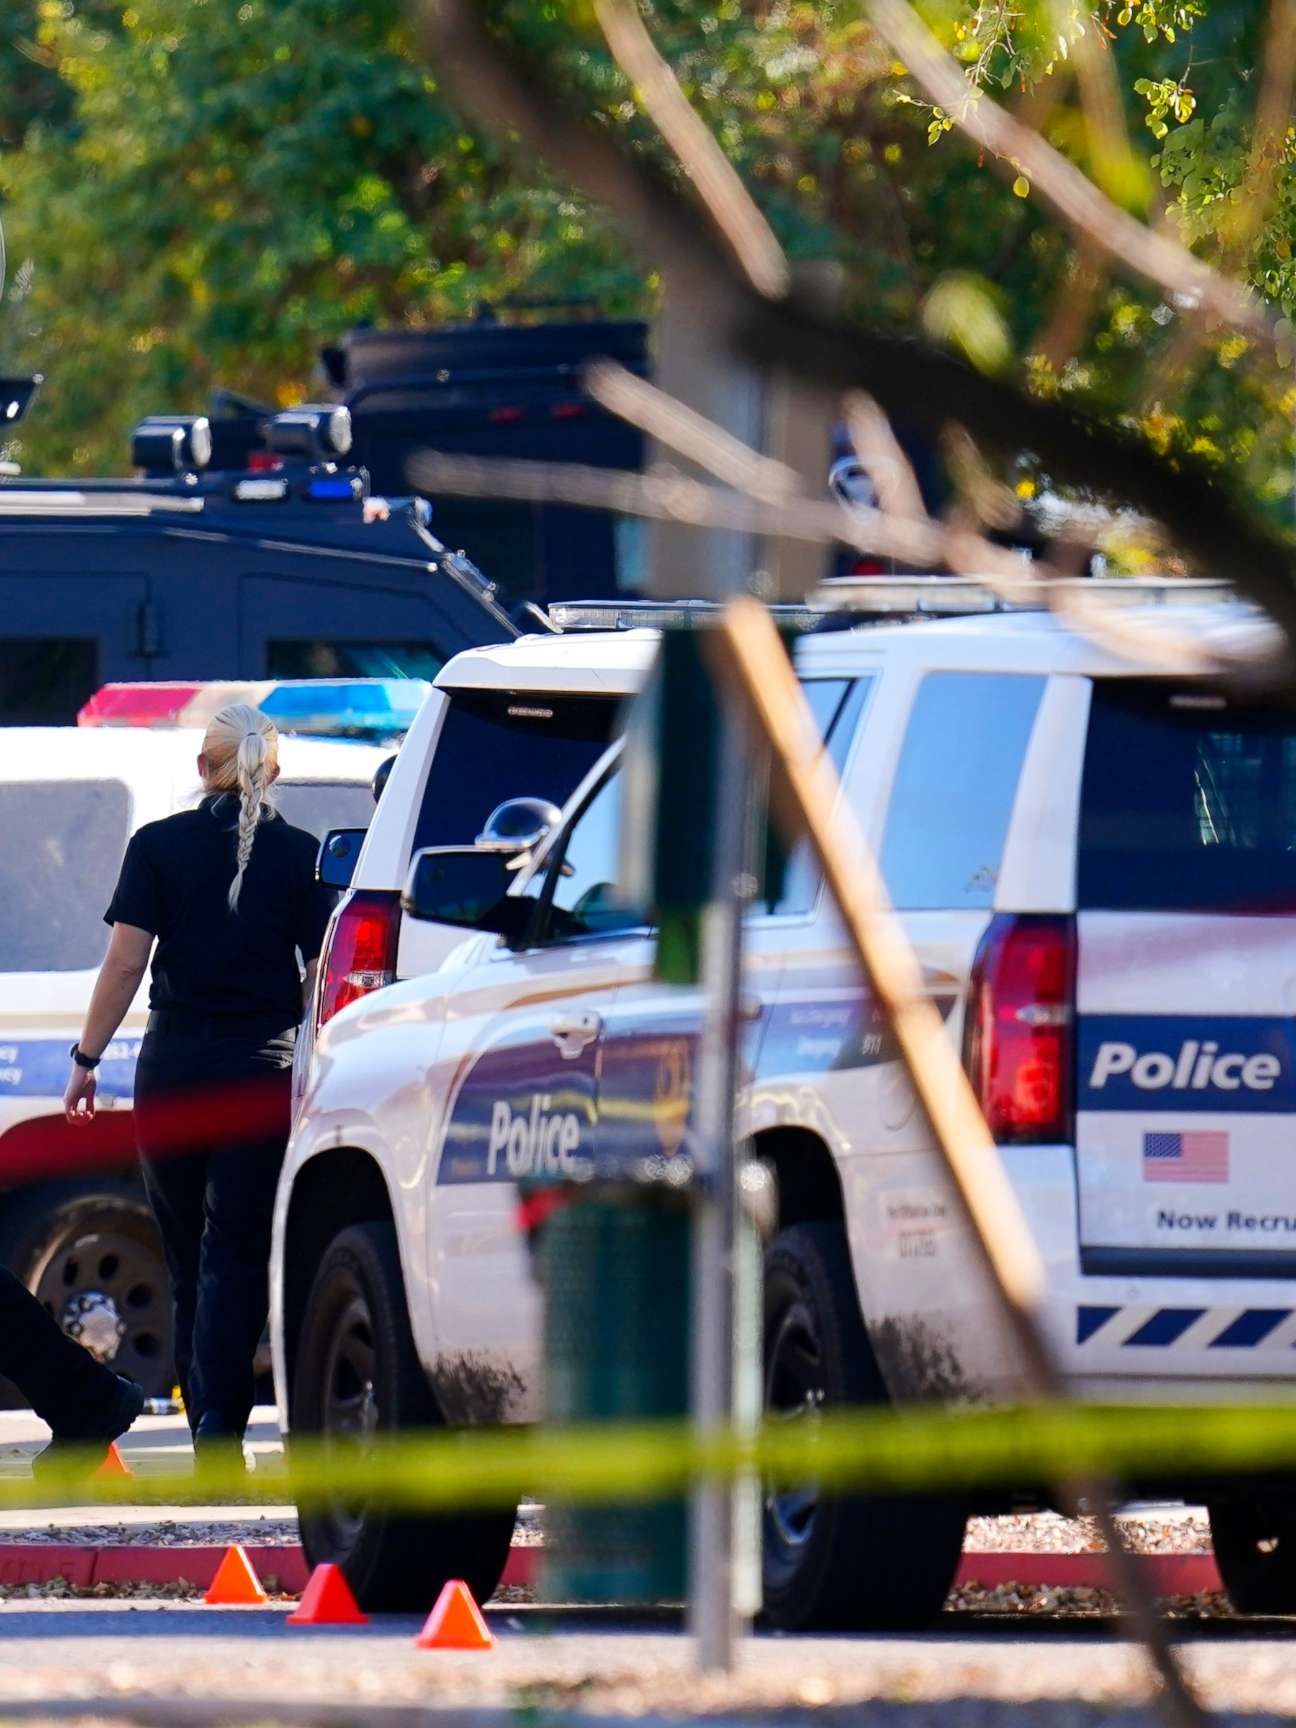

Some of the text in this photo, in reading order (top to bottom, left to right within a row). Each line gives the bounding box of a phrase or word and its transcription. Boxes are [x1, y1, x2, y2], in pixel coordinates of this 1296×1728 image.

[1089, 1040, 1281, 1089] Police
[486, 1093, 580, 1178] Police
[1157, 1209, 1216, 1230] Now
